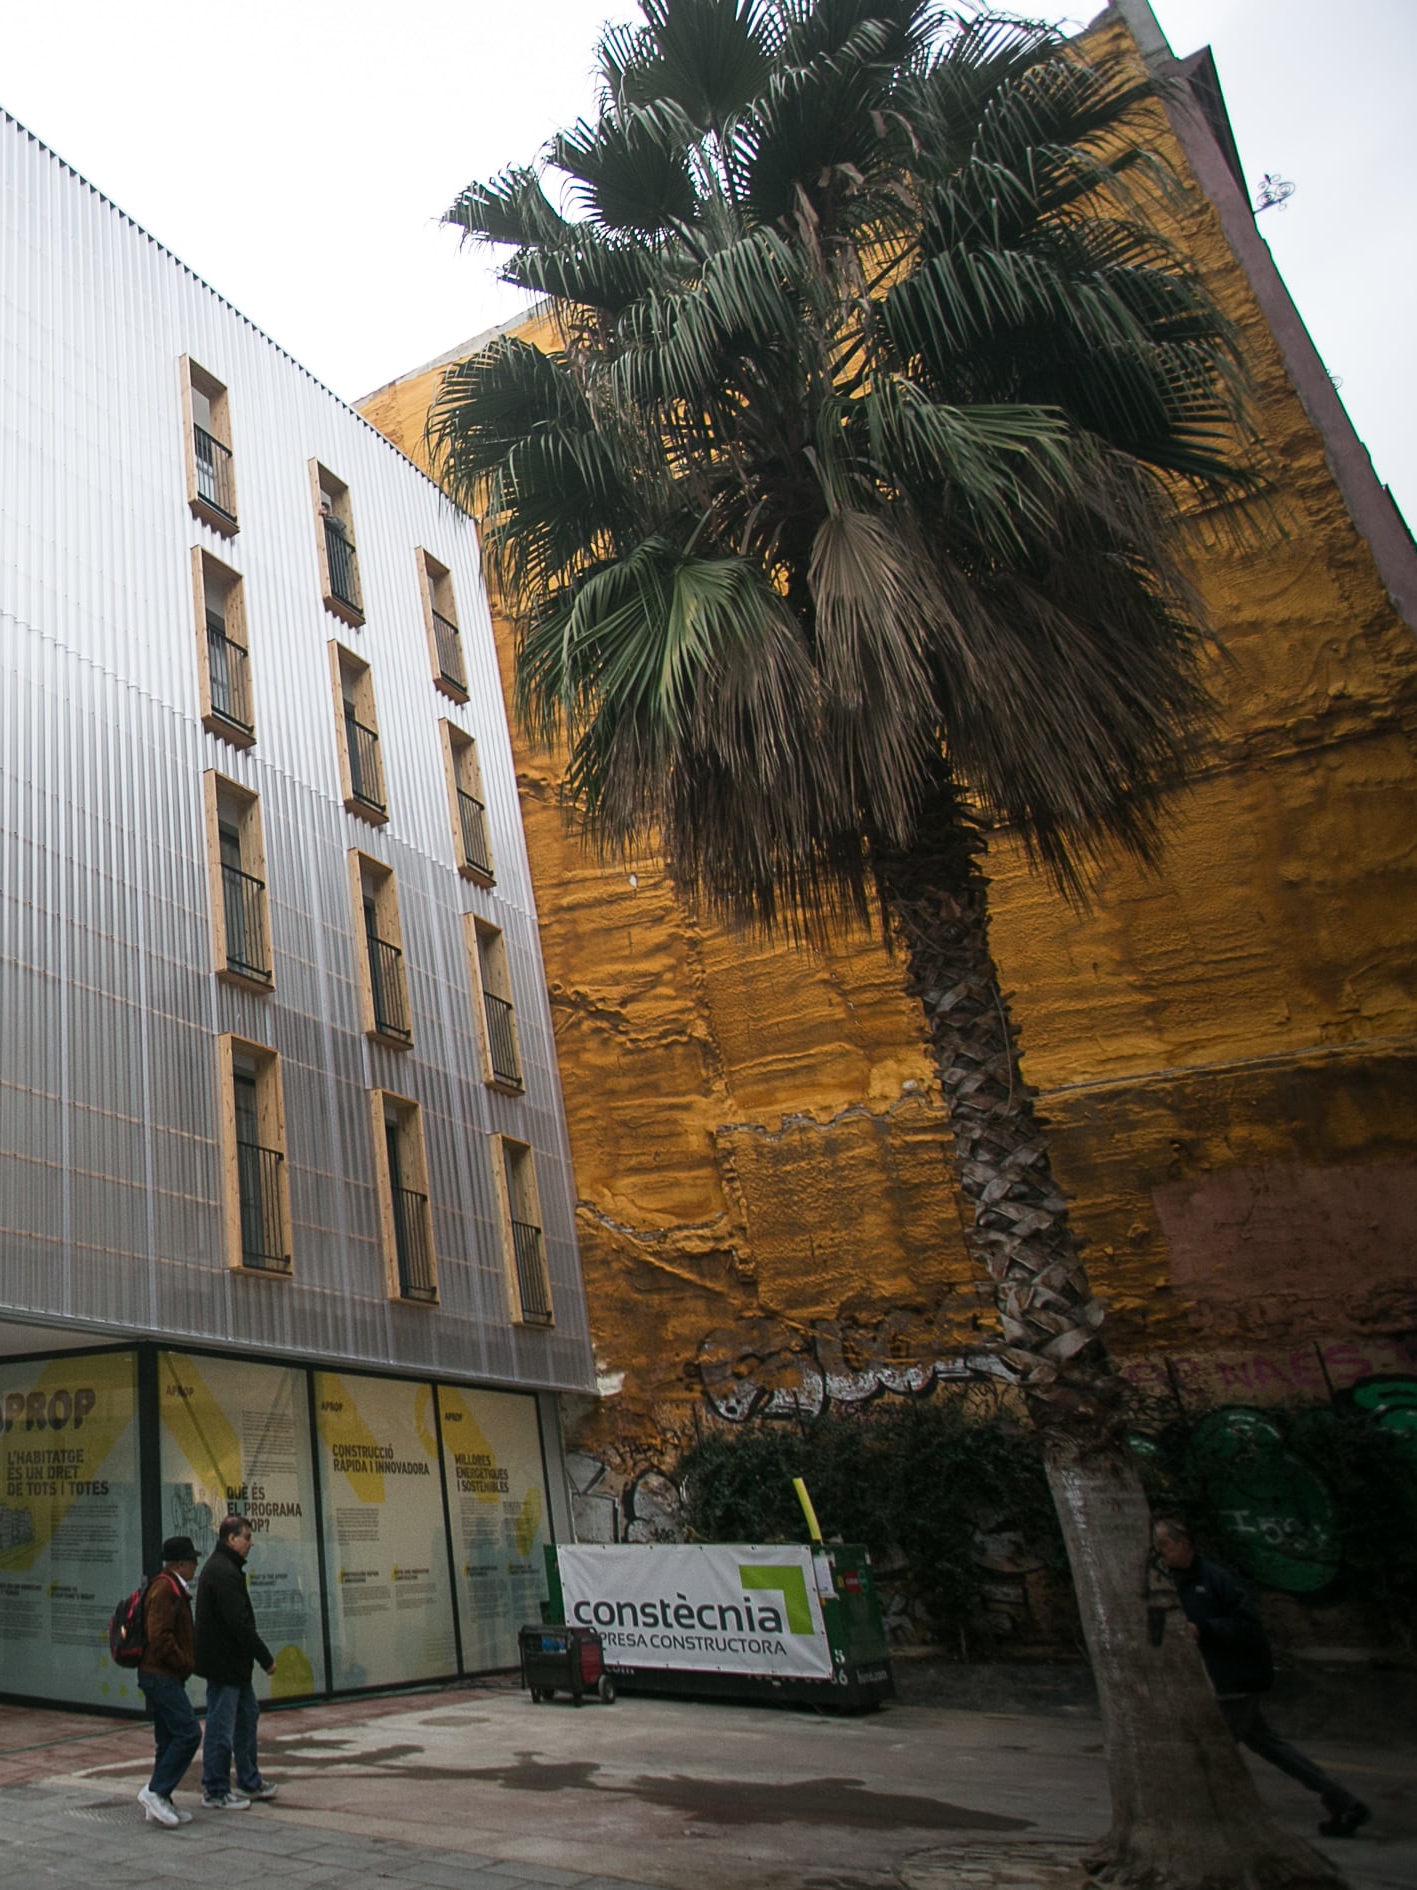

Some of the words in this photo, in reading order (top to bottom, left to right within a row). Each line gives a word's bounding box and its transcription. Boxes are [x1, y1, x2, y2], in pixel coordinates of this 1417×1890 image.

[7, 1449, 84, 1465] L'HABITATGE
[332, 1443, 394, 1459] CONSTRUCCIÓ
[369, 1461, 373, 1473] I
[374, 1460, 430, 1475] INNOVADORA
[454, 1454, 491, 1466] MILLORES
[26, 1466, 43, 1479] UN
[47, 1465, 78, 1479] DRET
[6, 1482, 23, 1496] DE
[26, 1481, 56, 1496] TOTS
[60, 1481, 64, 1496] I
[68, 1480, 109, 1495] TOTES
[251, 1483, 265, 1500] ÉS
[227, 1503, 241, 1516] EL
[244, 1502, 302, 1517] PROGRAMA
[574, 1592, 783, 1634] constècnia
[650, 1634, 787, 1655] CONSTRUCTORA
